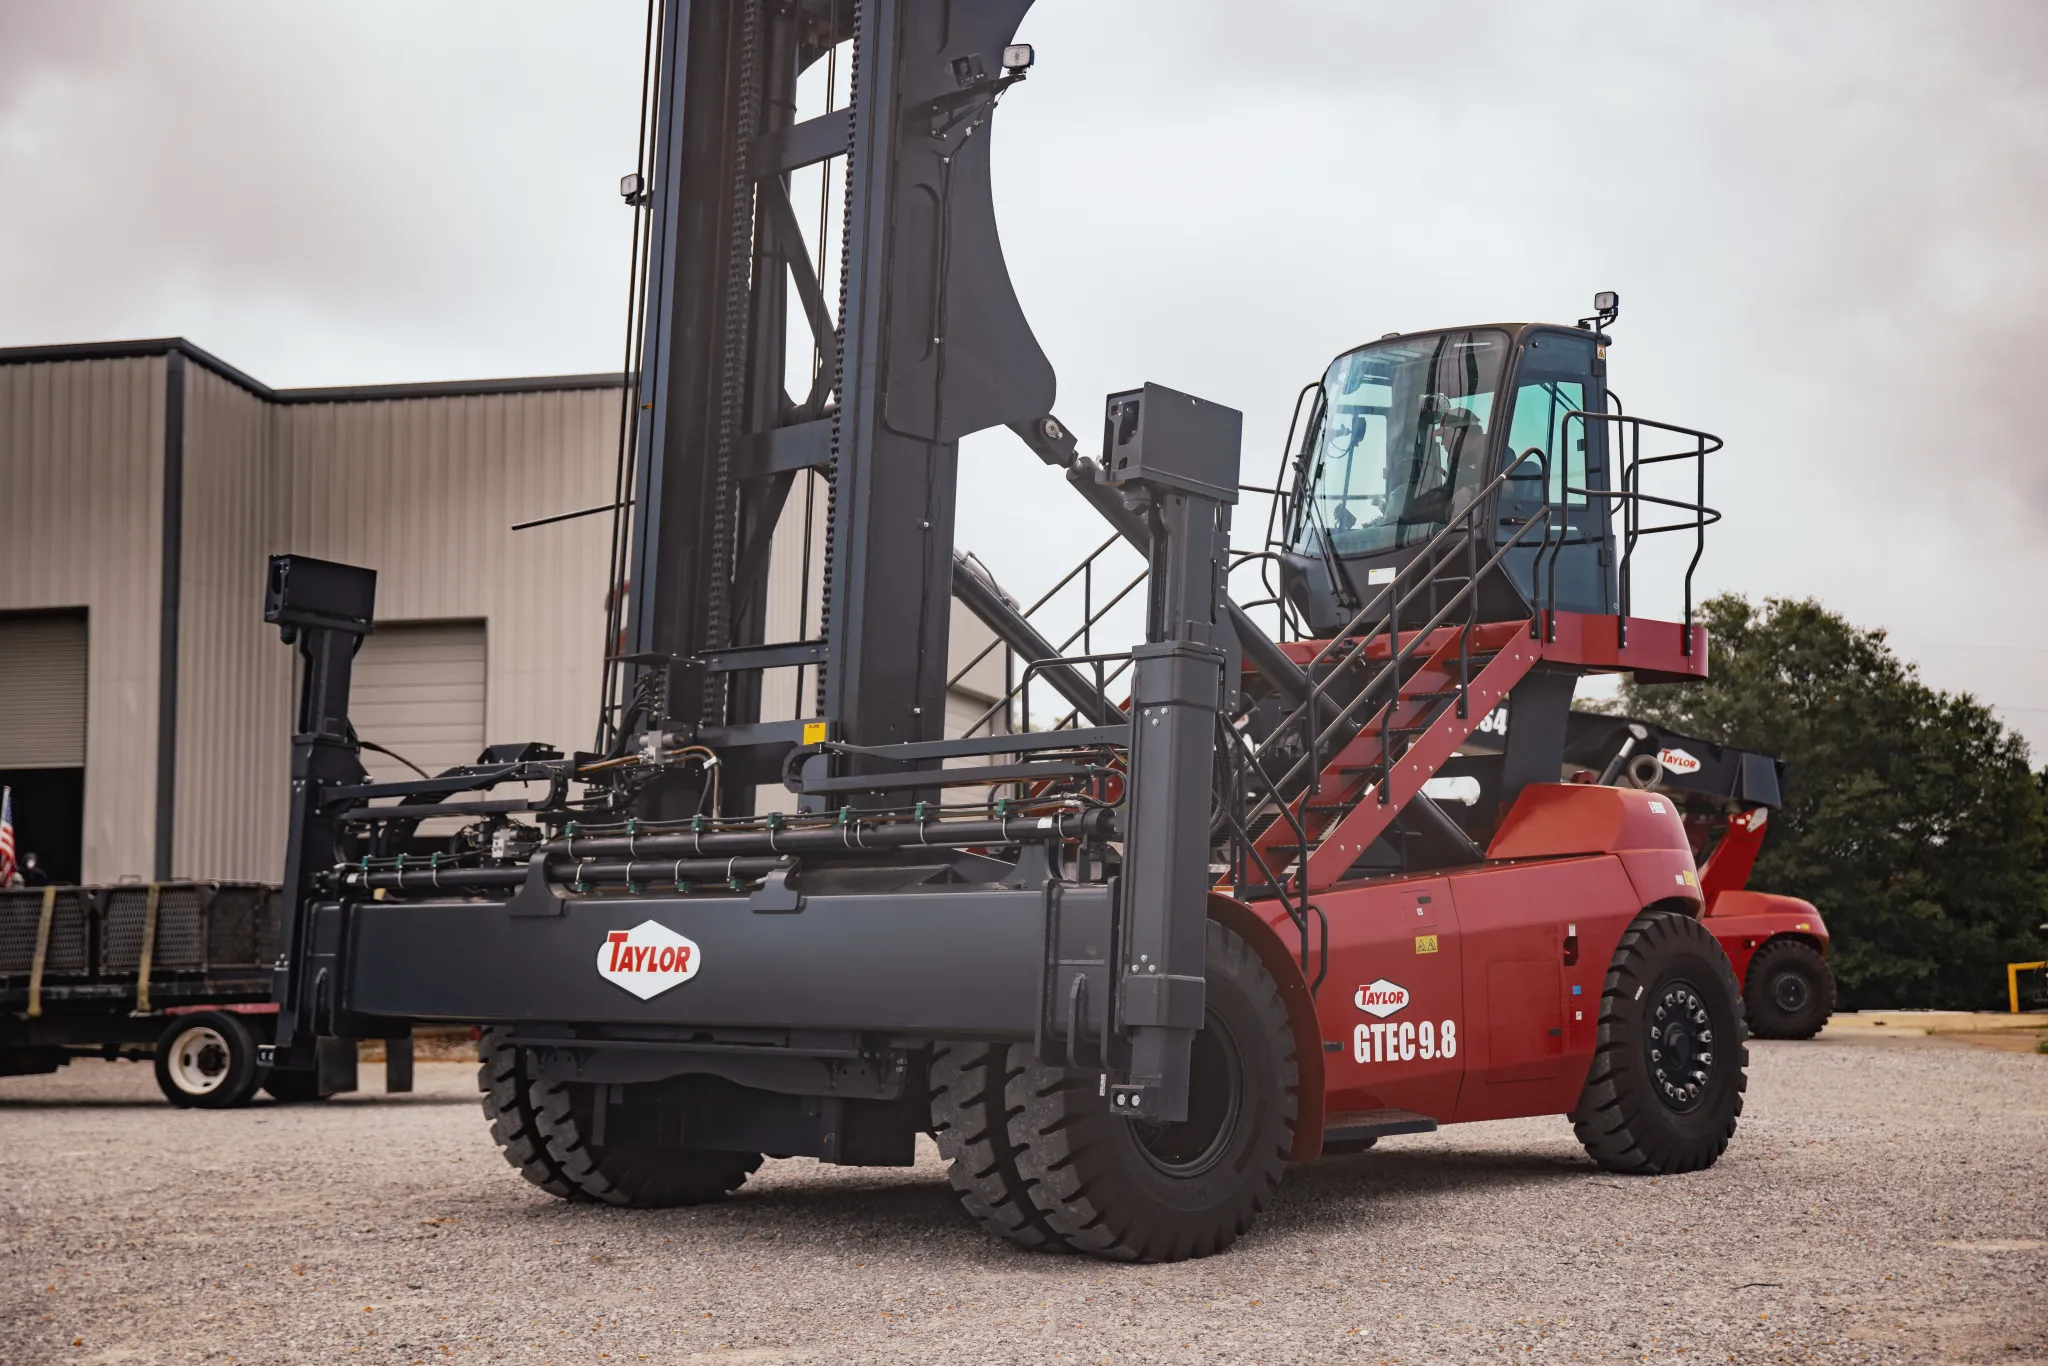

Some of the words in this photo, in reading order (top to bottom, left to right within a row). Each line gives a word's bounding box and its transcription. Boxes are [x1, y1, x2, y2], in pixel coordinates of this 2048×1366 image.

[1661, 750, 1697, 769] TAYLOR
[608, 932, 691, 973] TAYLOR
[1359, 985, 1405, 1006] TAYLOR
[1353, 1021, 1416, 1064] GTEC
[1418, 1019, 1457, 1060] 9.8
